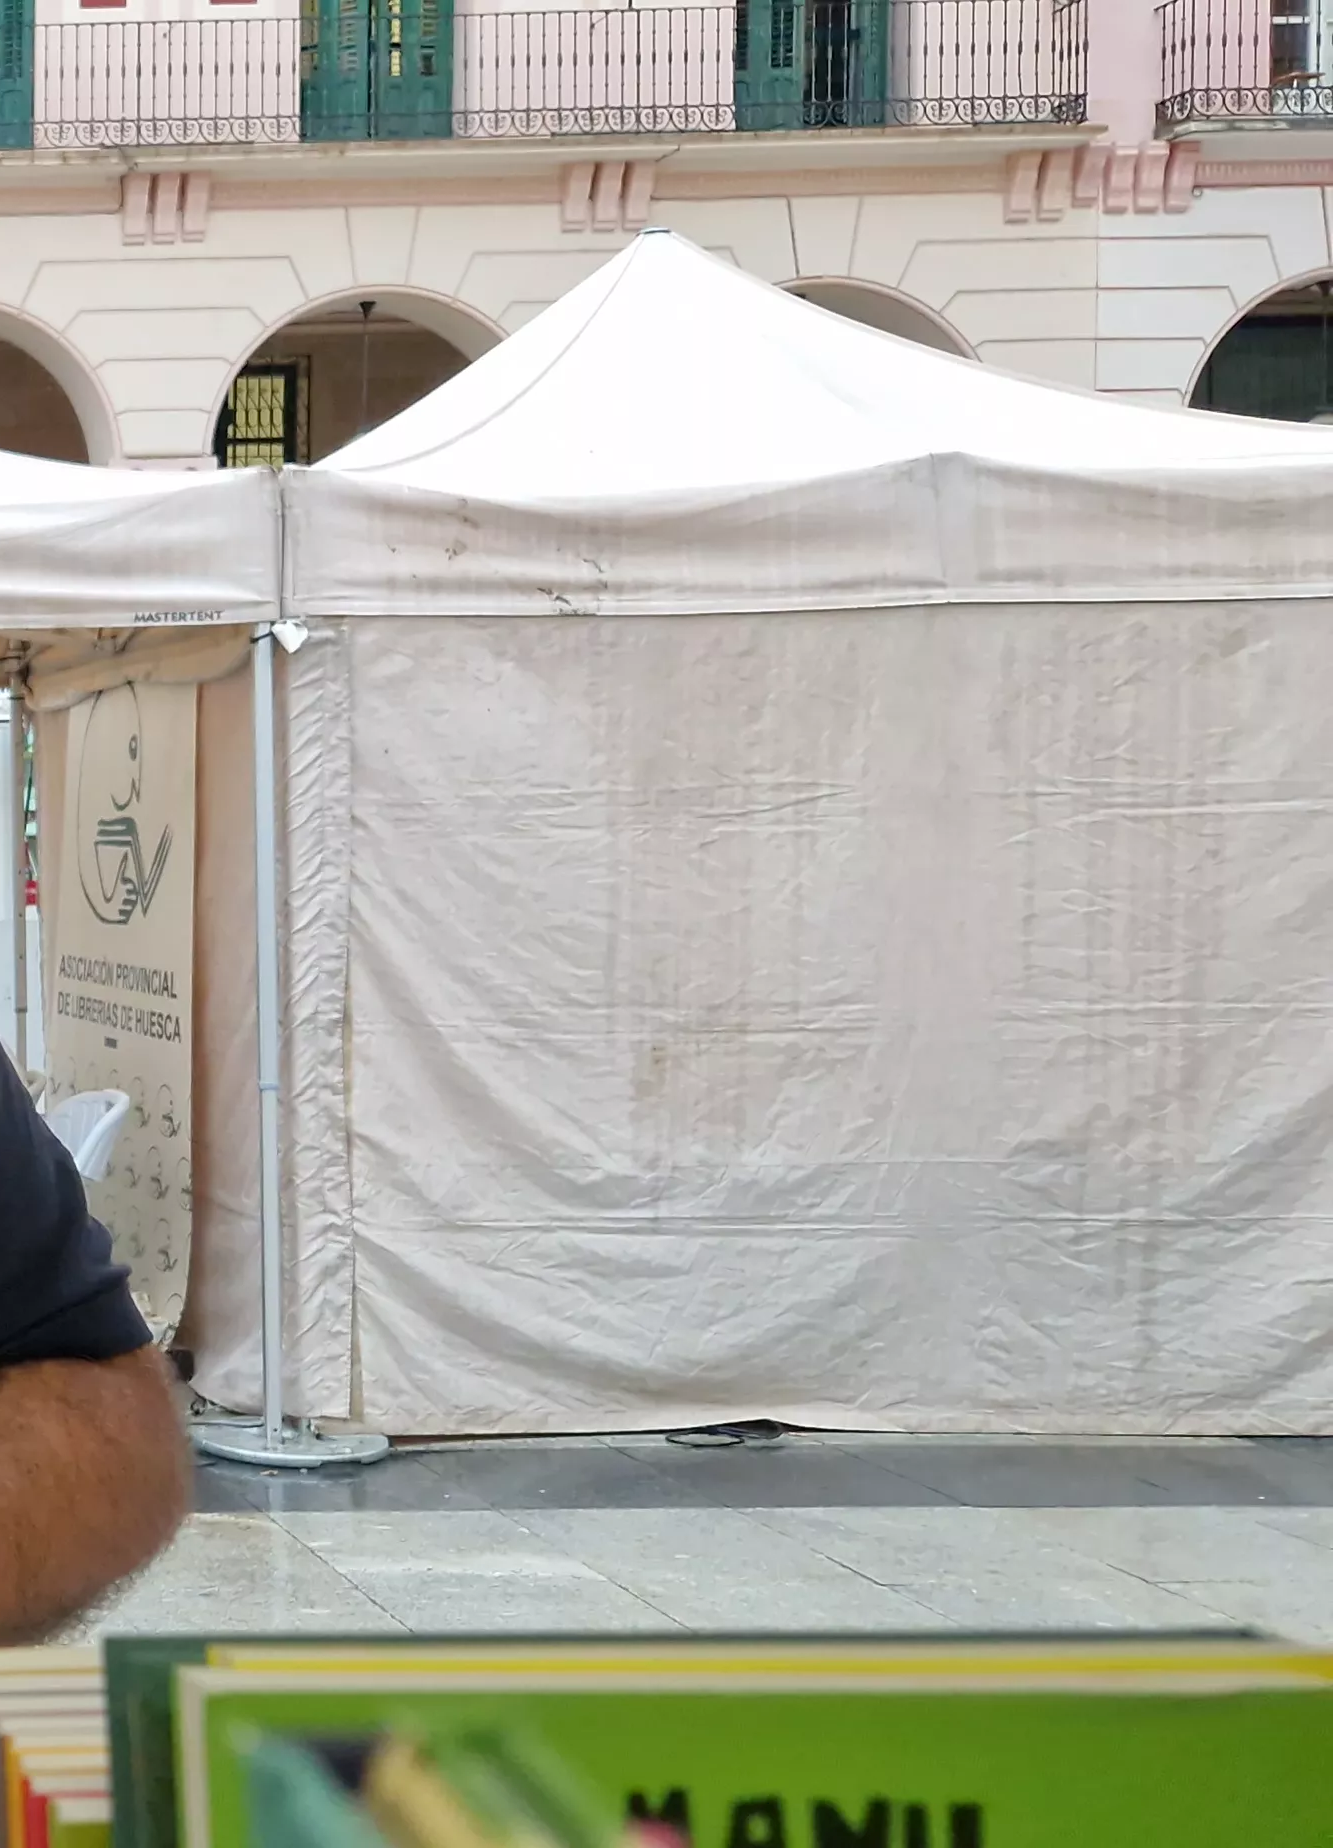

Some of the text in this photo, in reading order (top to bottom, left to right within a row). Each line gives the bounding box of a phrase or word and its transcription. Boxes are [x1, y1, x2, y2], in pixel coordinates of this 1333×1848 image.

[134, 610, 224, 623] MASTERTENT
[59, 955, 177, 999] ASOCIACIÓN PROVINCIAL
[57, 991, 70, 1016] DE
[120, 1005, 133, 1032] DE
[135, 1008, 181, 1043] HUESCA
